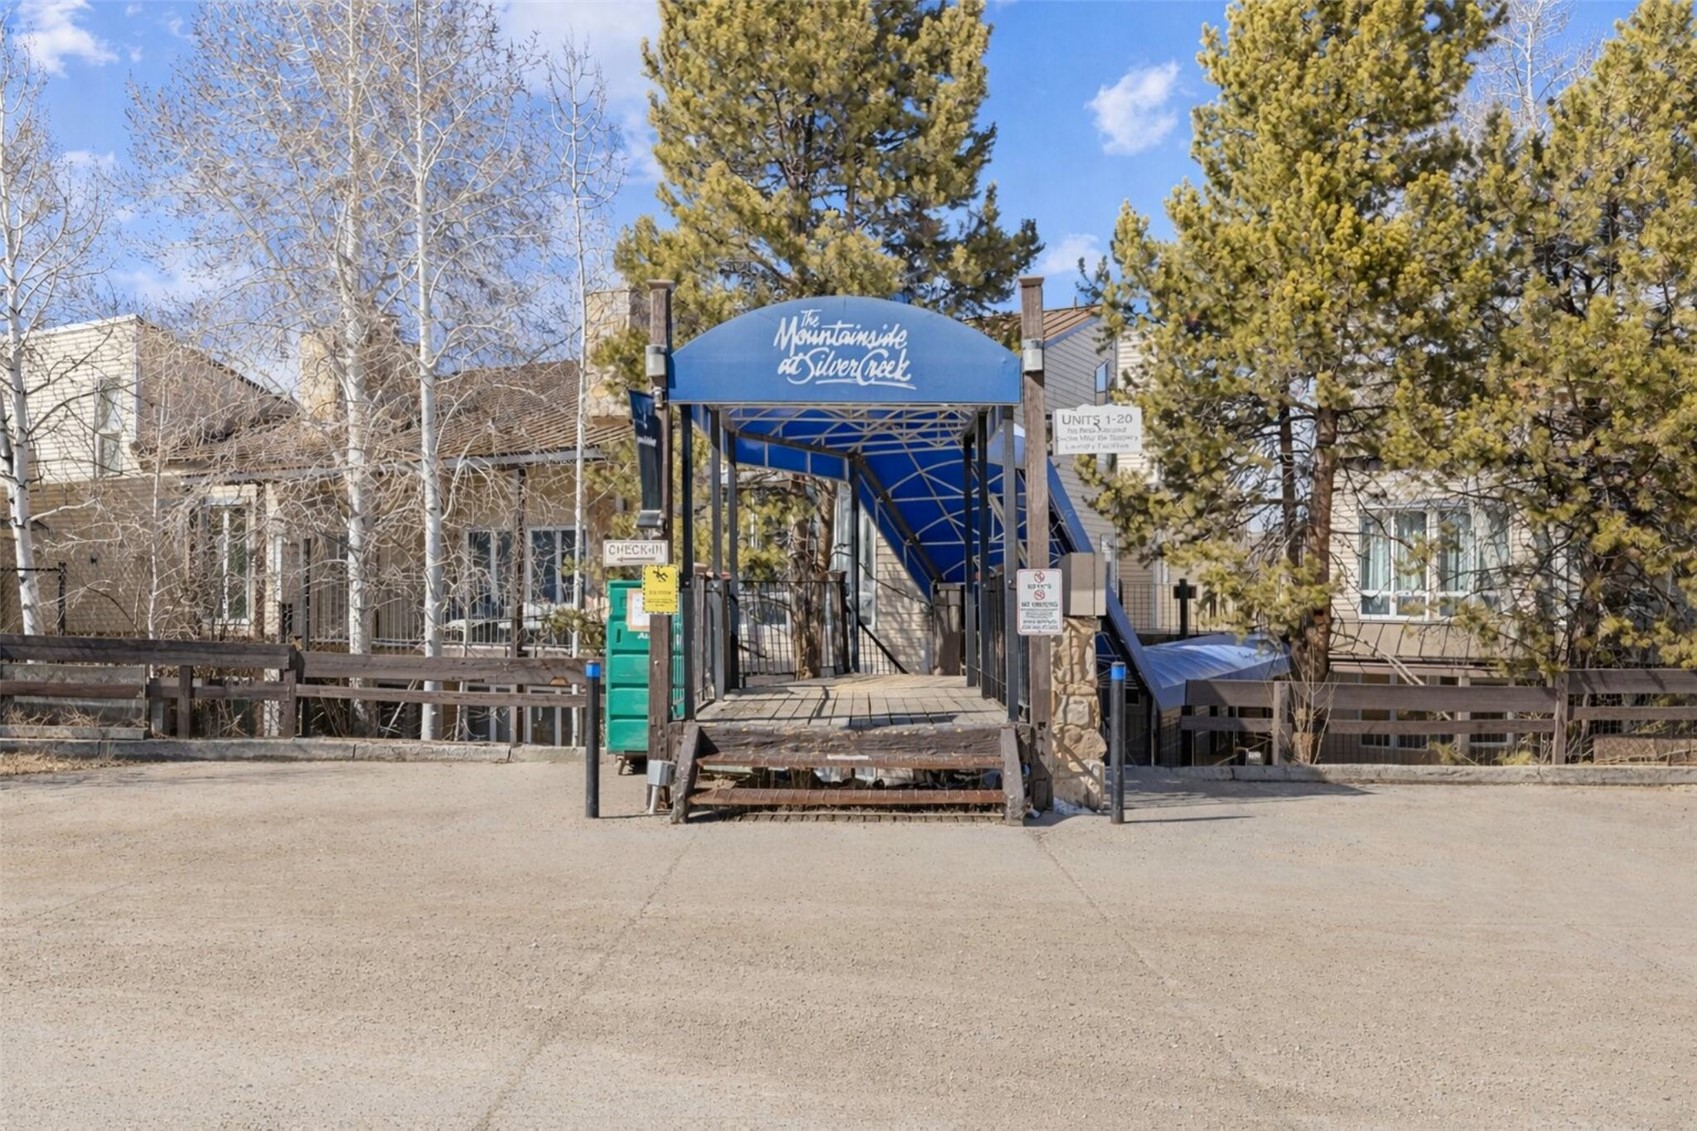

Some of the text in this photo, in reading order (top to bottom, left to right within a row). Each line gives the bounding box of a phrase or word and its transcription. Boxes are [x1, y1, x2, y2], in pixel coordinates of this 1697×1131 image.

[800, 308, 822, 328] The
[773, 316, 908, 356] Mountainside
[1062, 413, 1133, 425] UNITS 1-20
